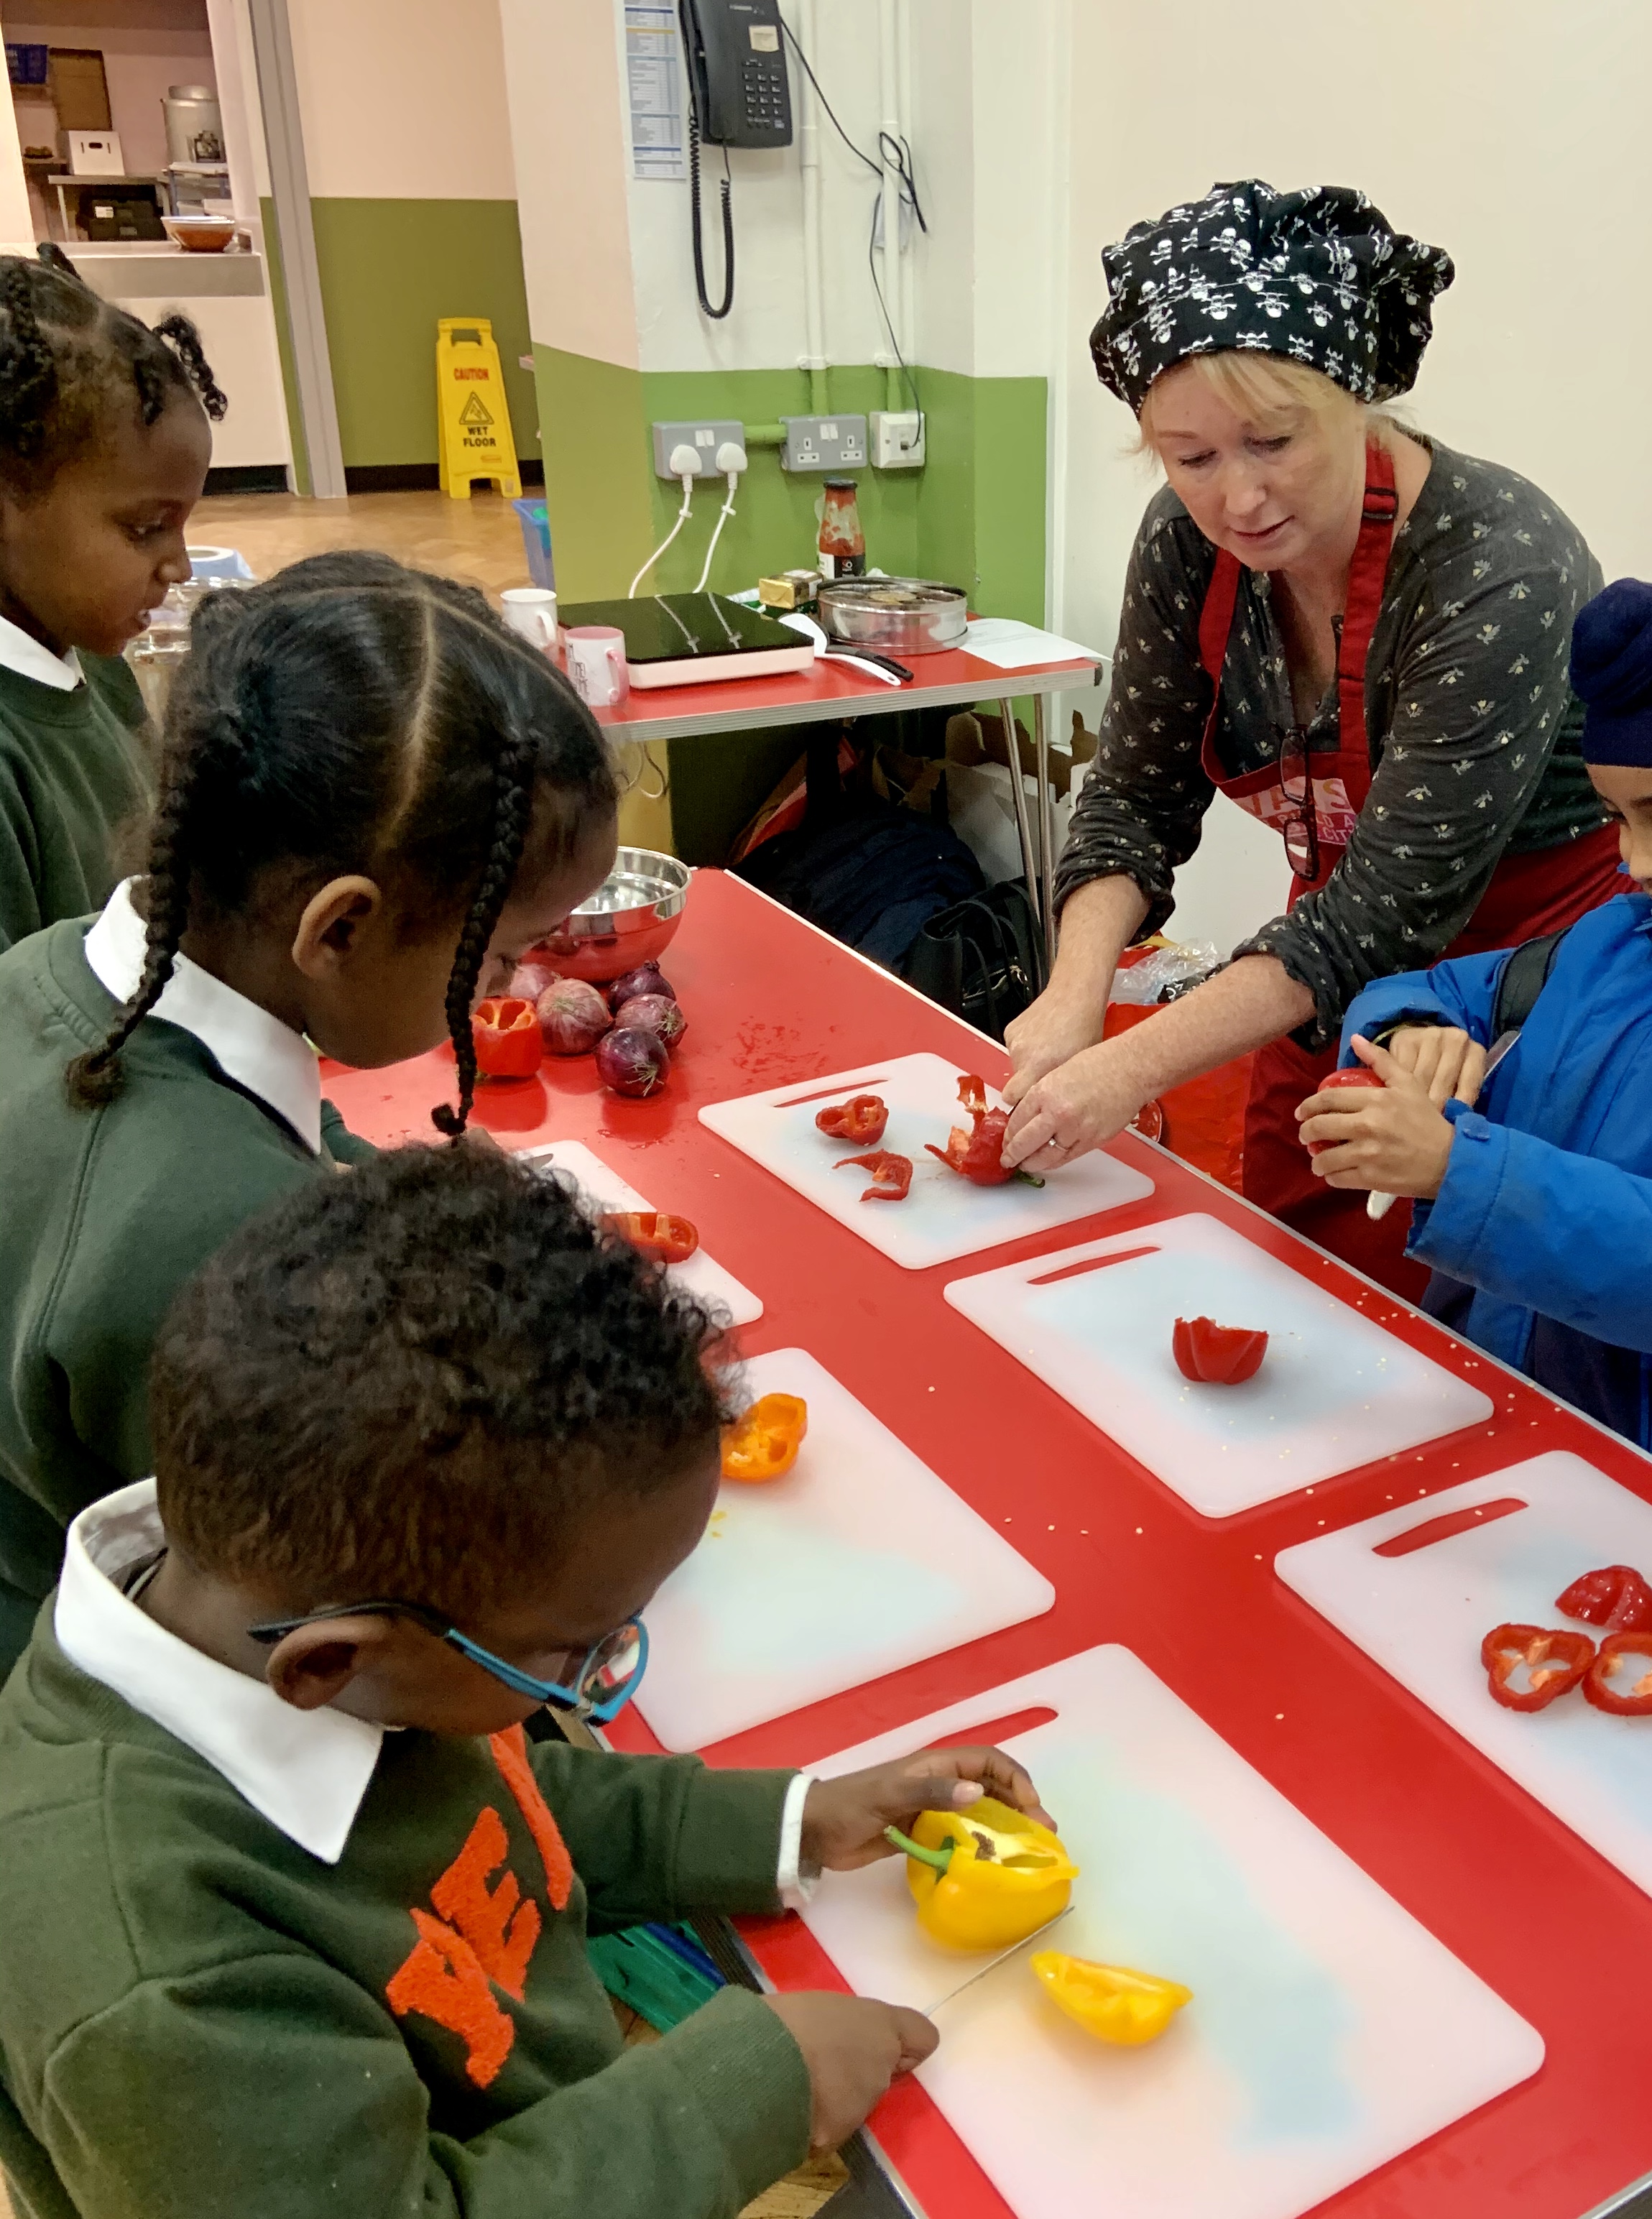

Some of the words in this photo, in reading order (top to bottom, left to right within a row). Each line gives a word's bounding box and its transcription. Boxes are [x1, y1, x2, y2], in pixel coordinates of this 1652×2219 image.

[453, 367, 489, 381] CAUTION
[467, 426, 489, 435] WET
[463, 438, 497, 447] FLOOR
